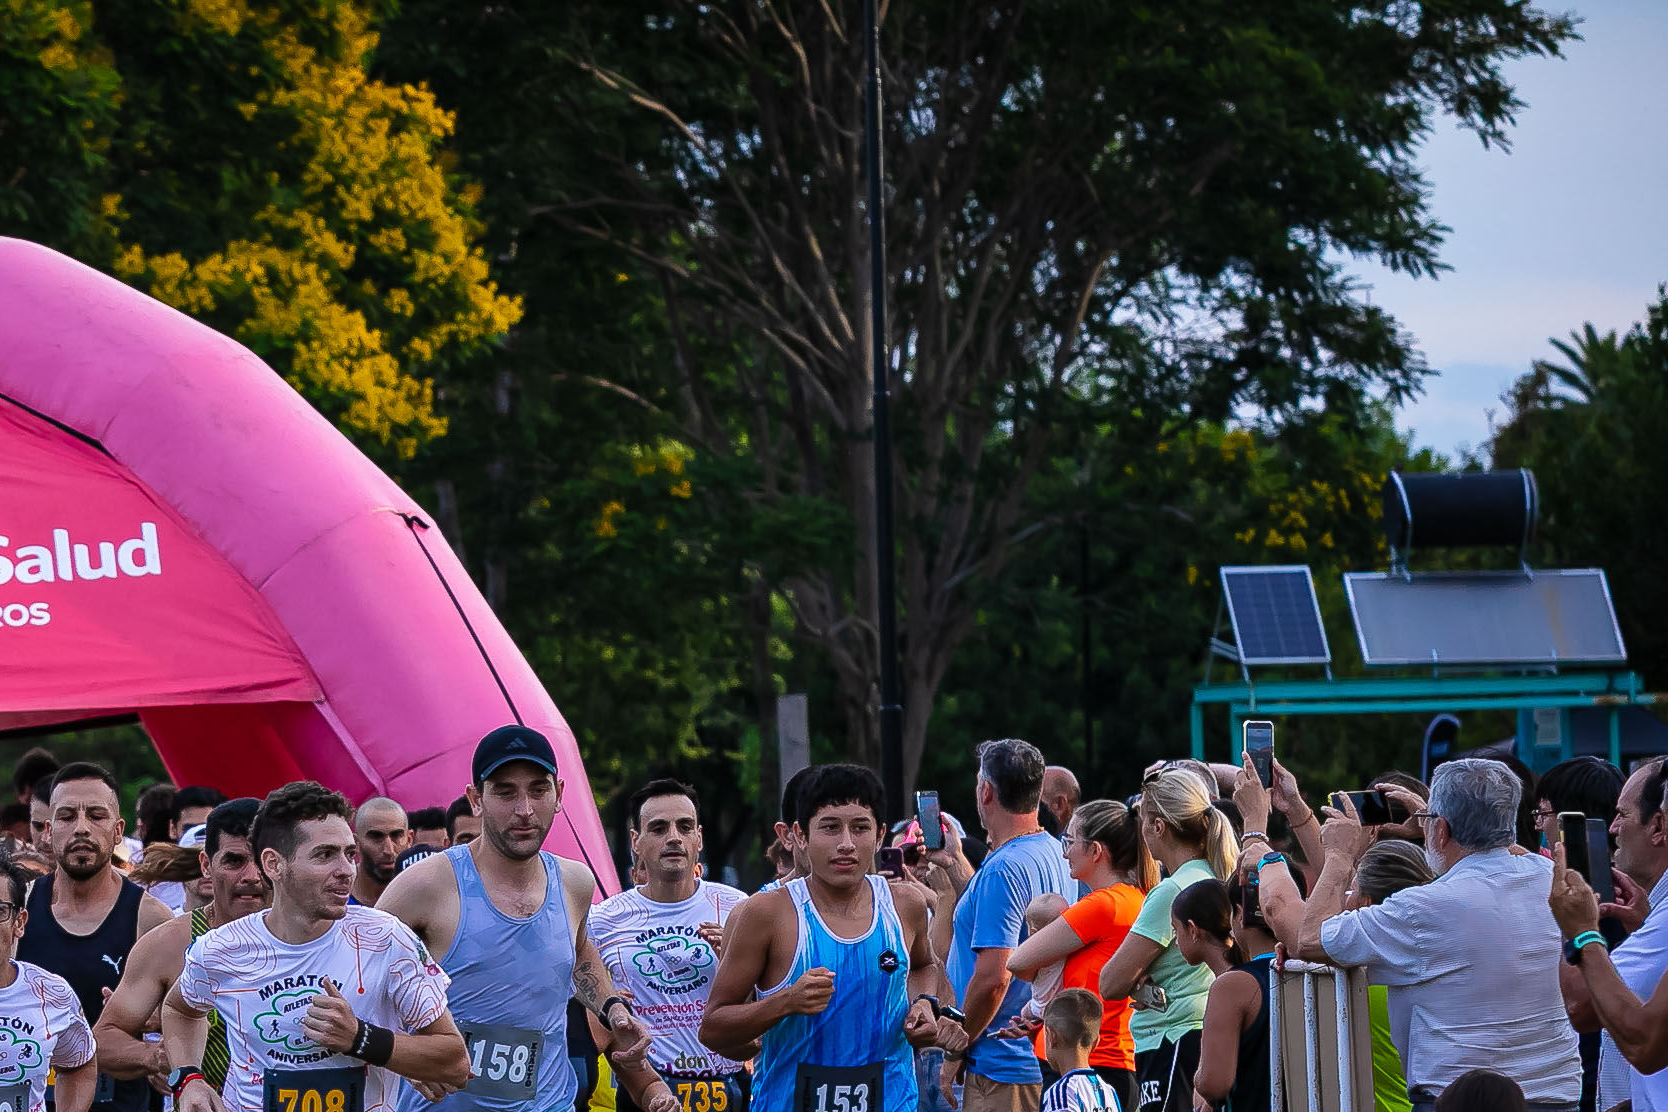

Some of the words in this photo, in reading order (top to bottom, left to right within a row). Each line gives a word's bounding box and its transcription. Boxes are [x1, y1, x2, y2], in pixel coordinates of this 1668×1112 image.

[645, 975, 709, 996] ANIVERSARIO
[266, 1048, 332, 1065] ANIVERSA
[470, 1039, 529, 1083] 158
[524, 1042, 538, 1088] EXACTO
[674, 1050, 709, 1070] don
